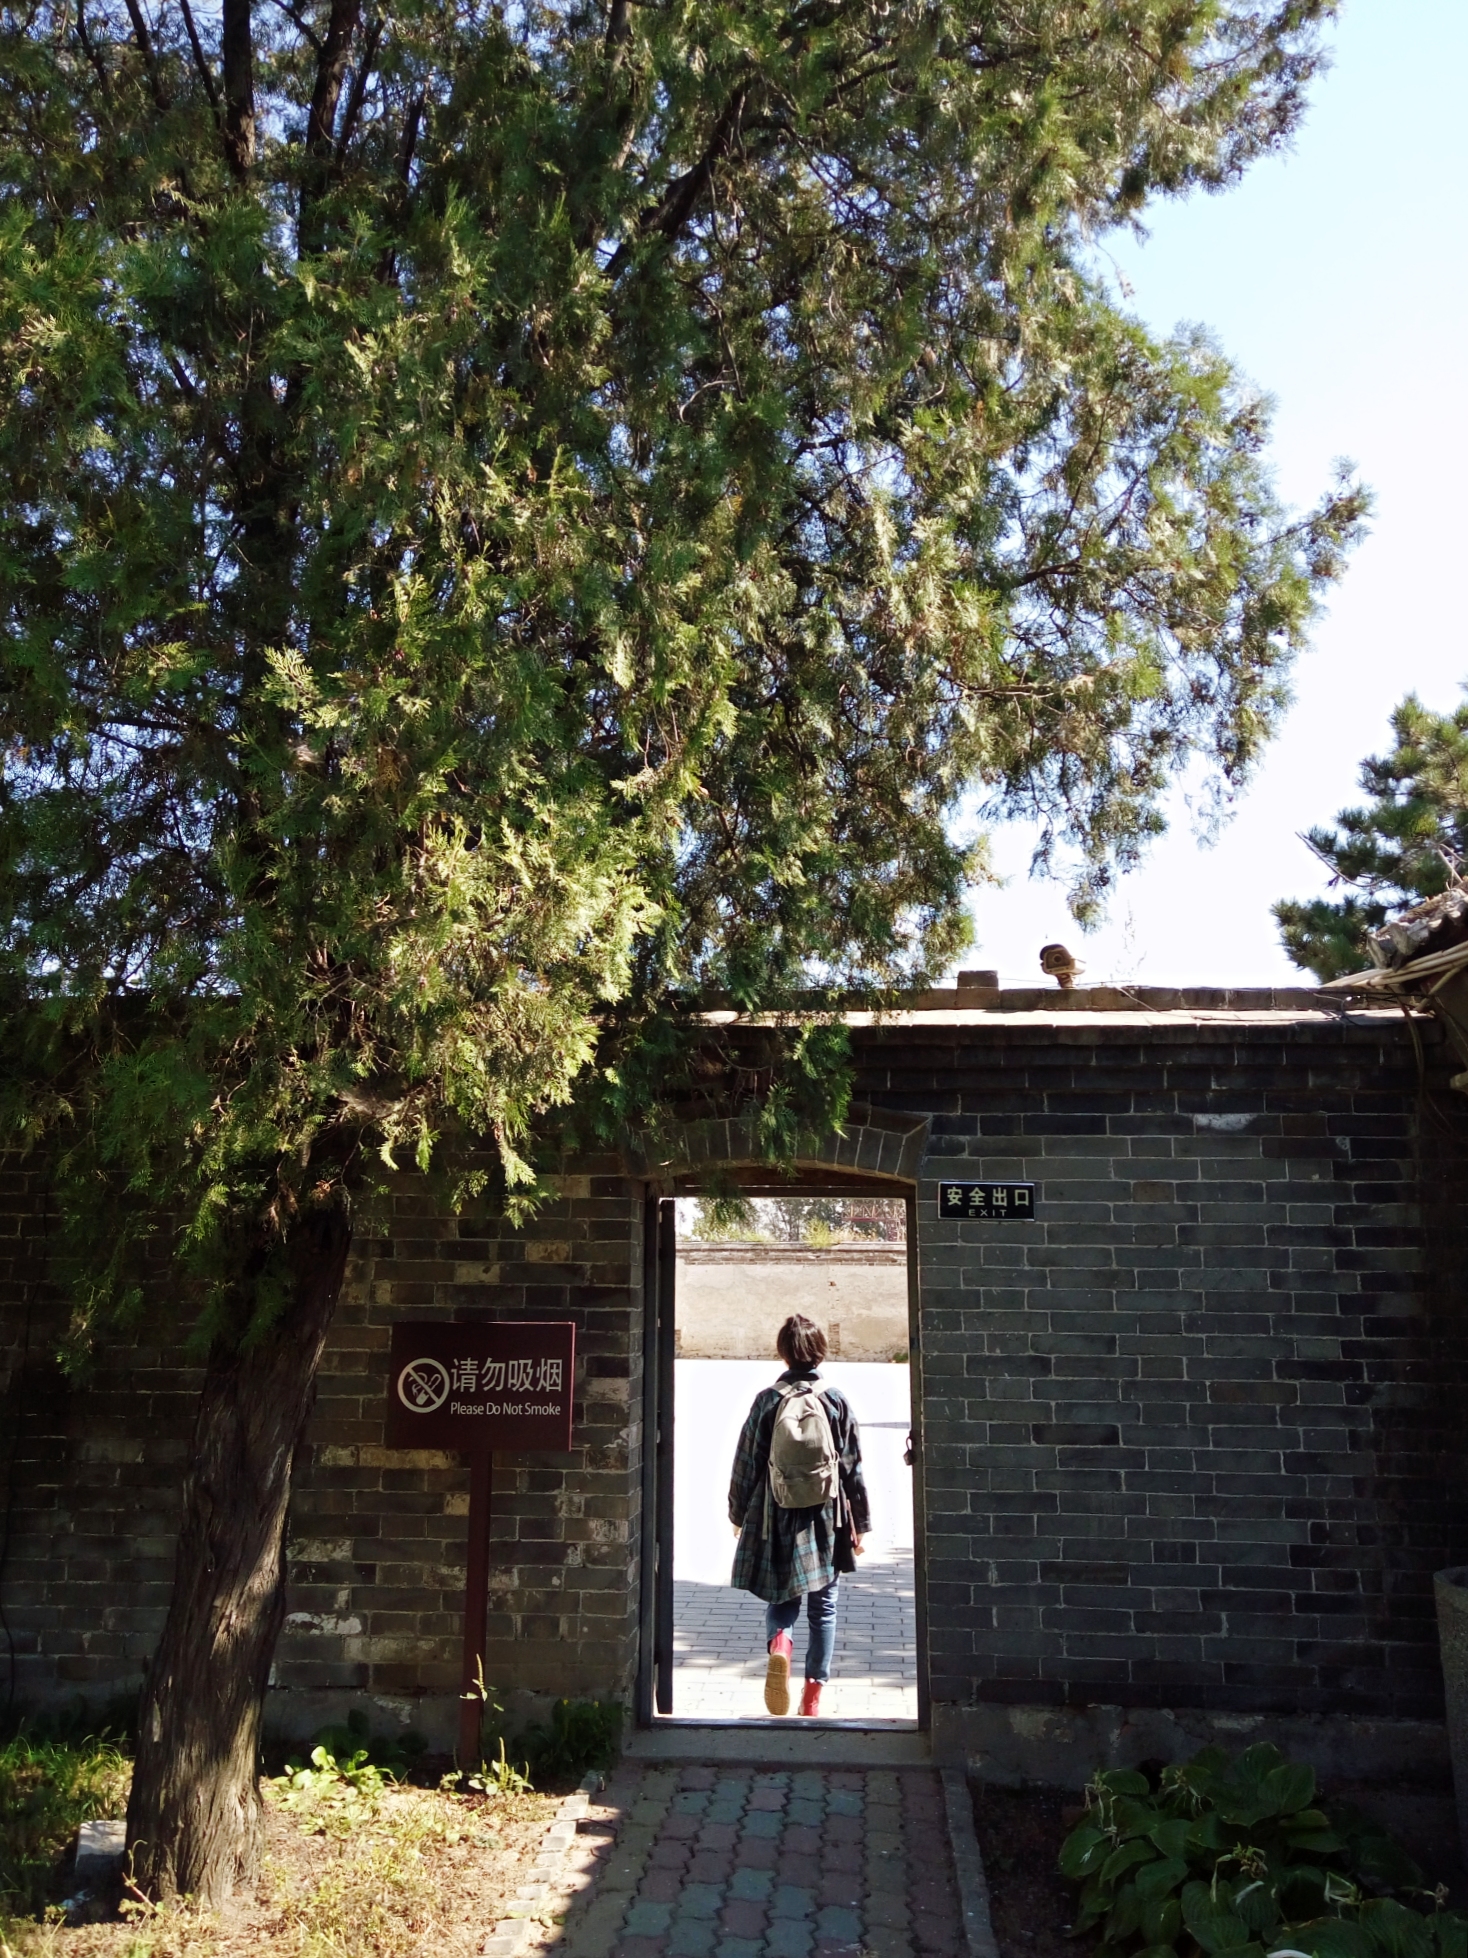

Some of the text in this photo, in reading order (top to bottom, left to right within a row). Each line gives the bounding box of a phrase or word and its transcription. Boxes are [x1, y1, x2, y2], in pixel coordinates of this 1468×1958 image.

[947, 1186, 1029, 1207] 安全出口
[968, 1209, 1007, 1217] EXIT
[450, 1357, 563, 1392] 请勿吸烟
[450, 1402, 561, 1415] Please Do Not Smoke
